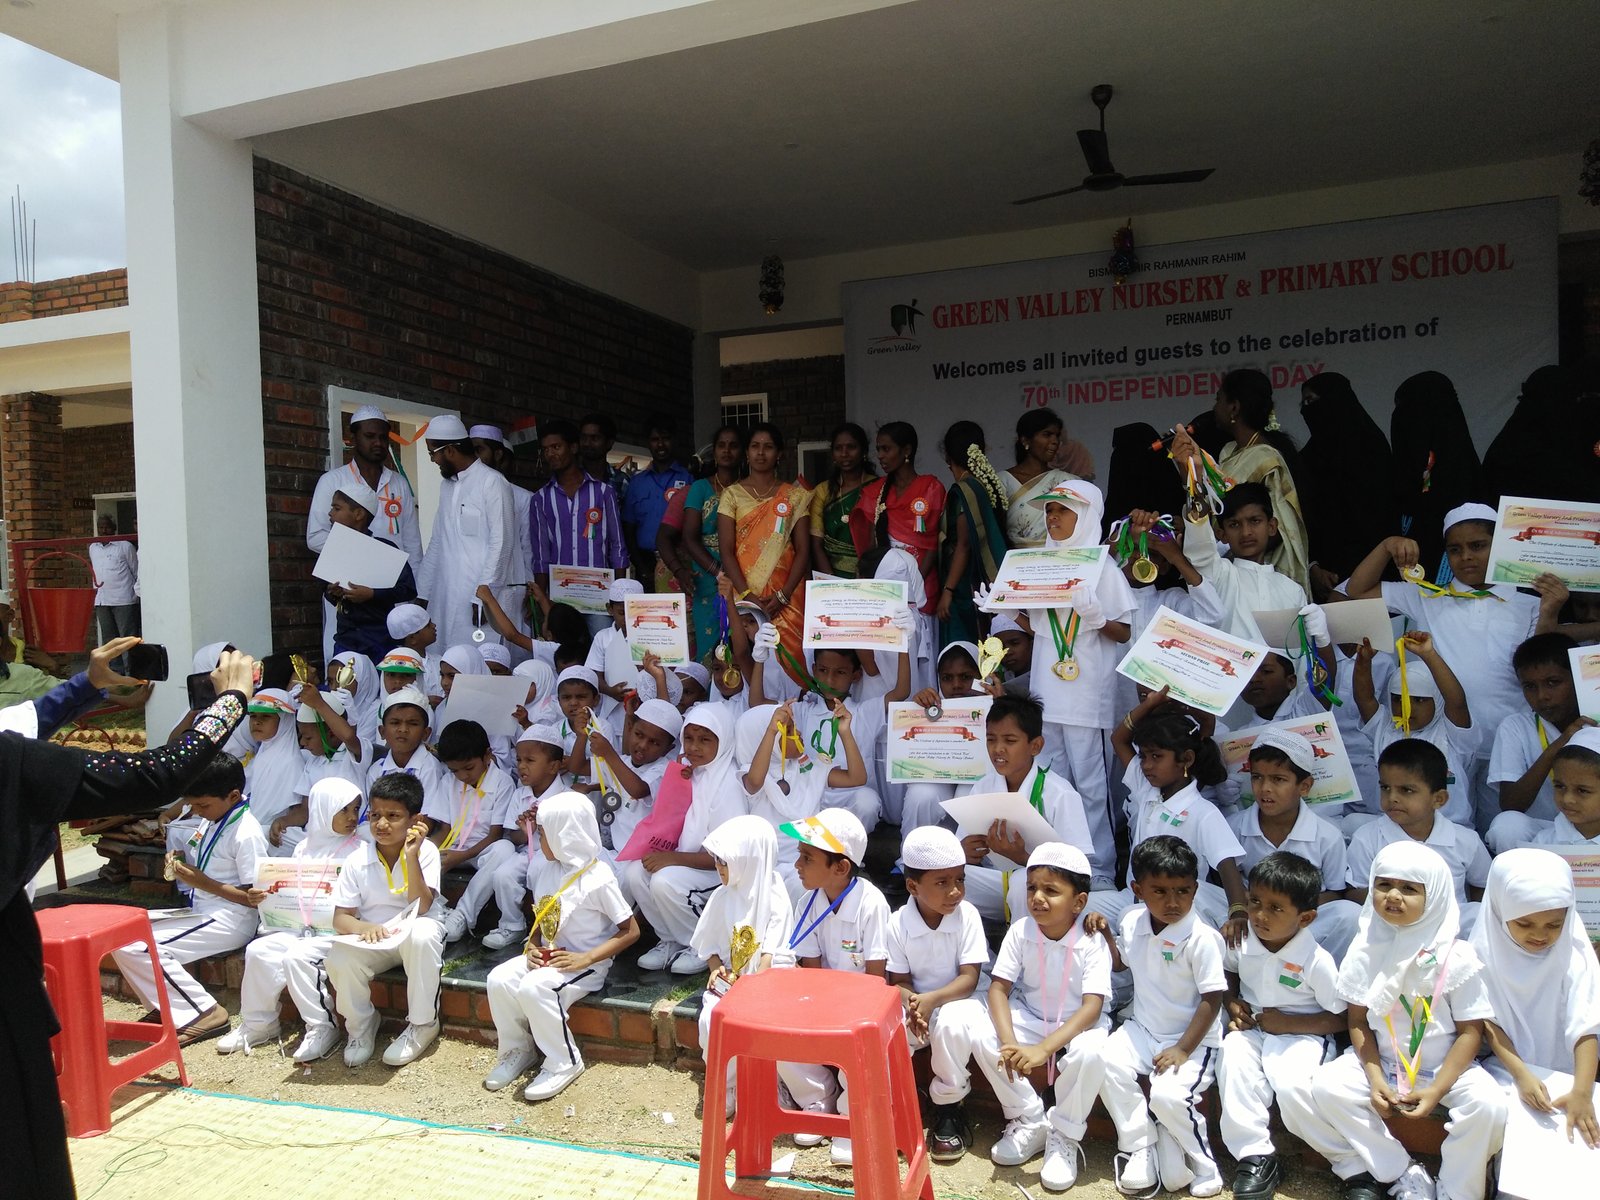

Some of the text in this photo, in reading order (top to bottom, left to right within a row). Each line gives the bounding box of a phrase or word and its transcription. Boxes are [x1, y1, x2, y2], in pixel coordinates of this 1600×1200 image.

[1154, 256, 1209, 271] RAHMANIR
[1212, 251, 1246, 264] RAHIM
[933, 243, 1514, 328] GREEN VALLEY NURSERY & PRIMARY SCHOOL
[1166, 308, 1233, 326] PERNAMBUT
[867, 343, 921, 355] Green Valley
[933, 317, 1439, 380] Welcomes all invited guests to the celebration of
[1023, 386, 1060, 408] 70th
[1068, 373, 1225, 405] INDEPENDEN
